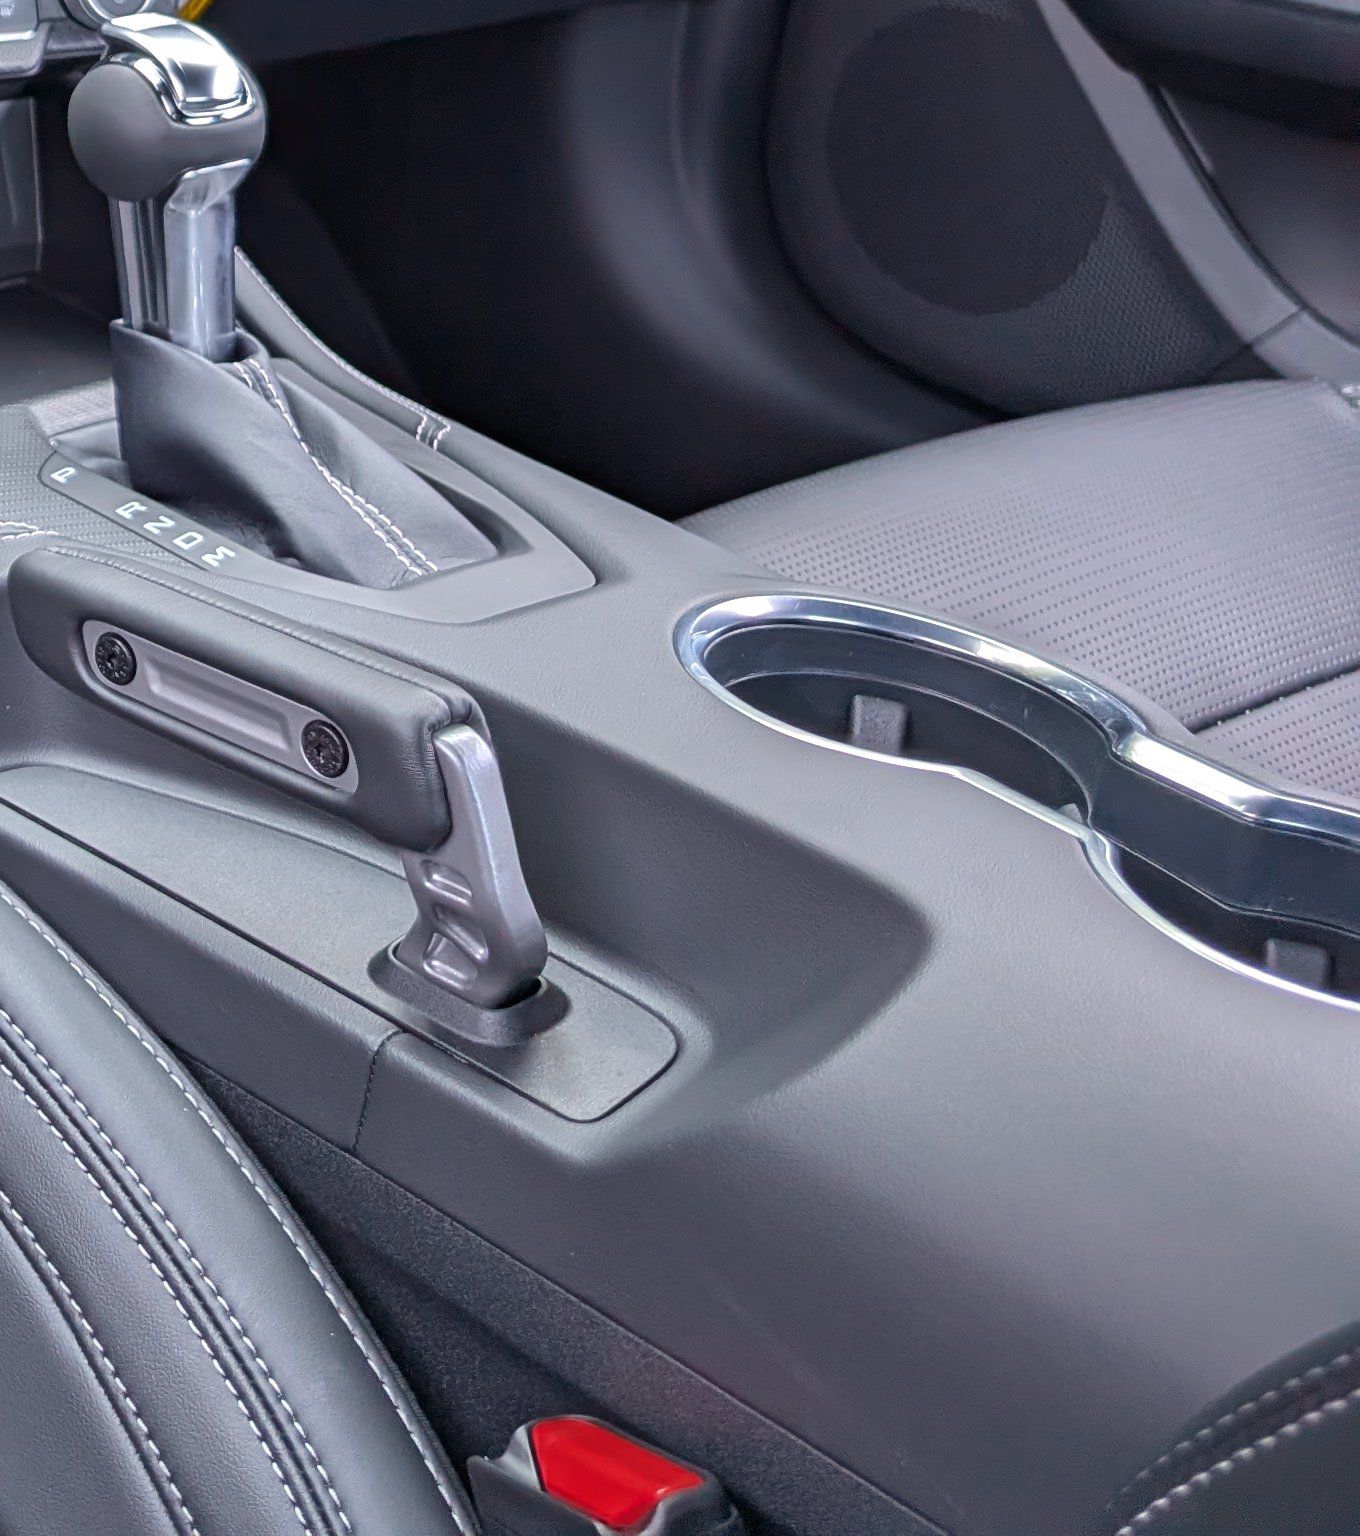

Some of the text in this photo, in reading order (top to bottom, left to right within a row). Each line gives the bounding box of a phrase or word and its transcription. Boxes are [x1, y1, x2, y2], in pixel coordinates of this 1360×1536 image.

[50, 466, 236, 567] P R N D M
